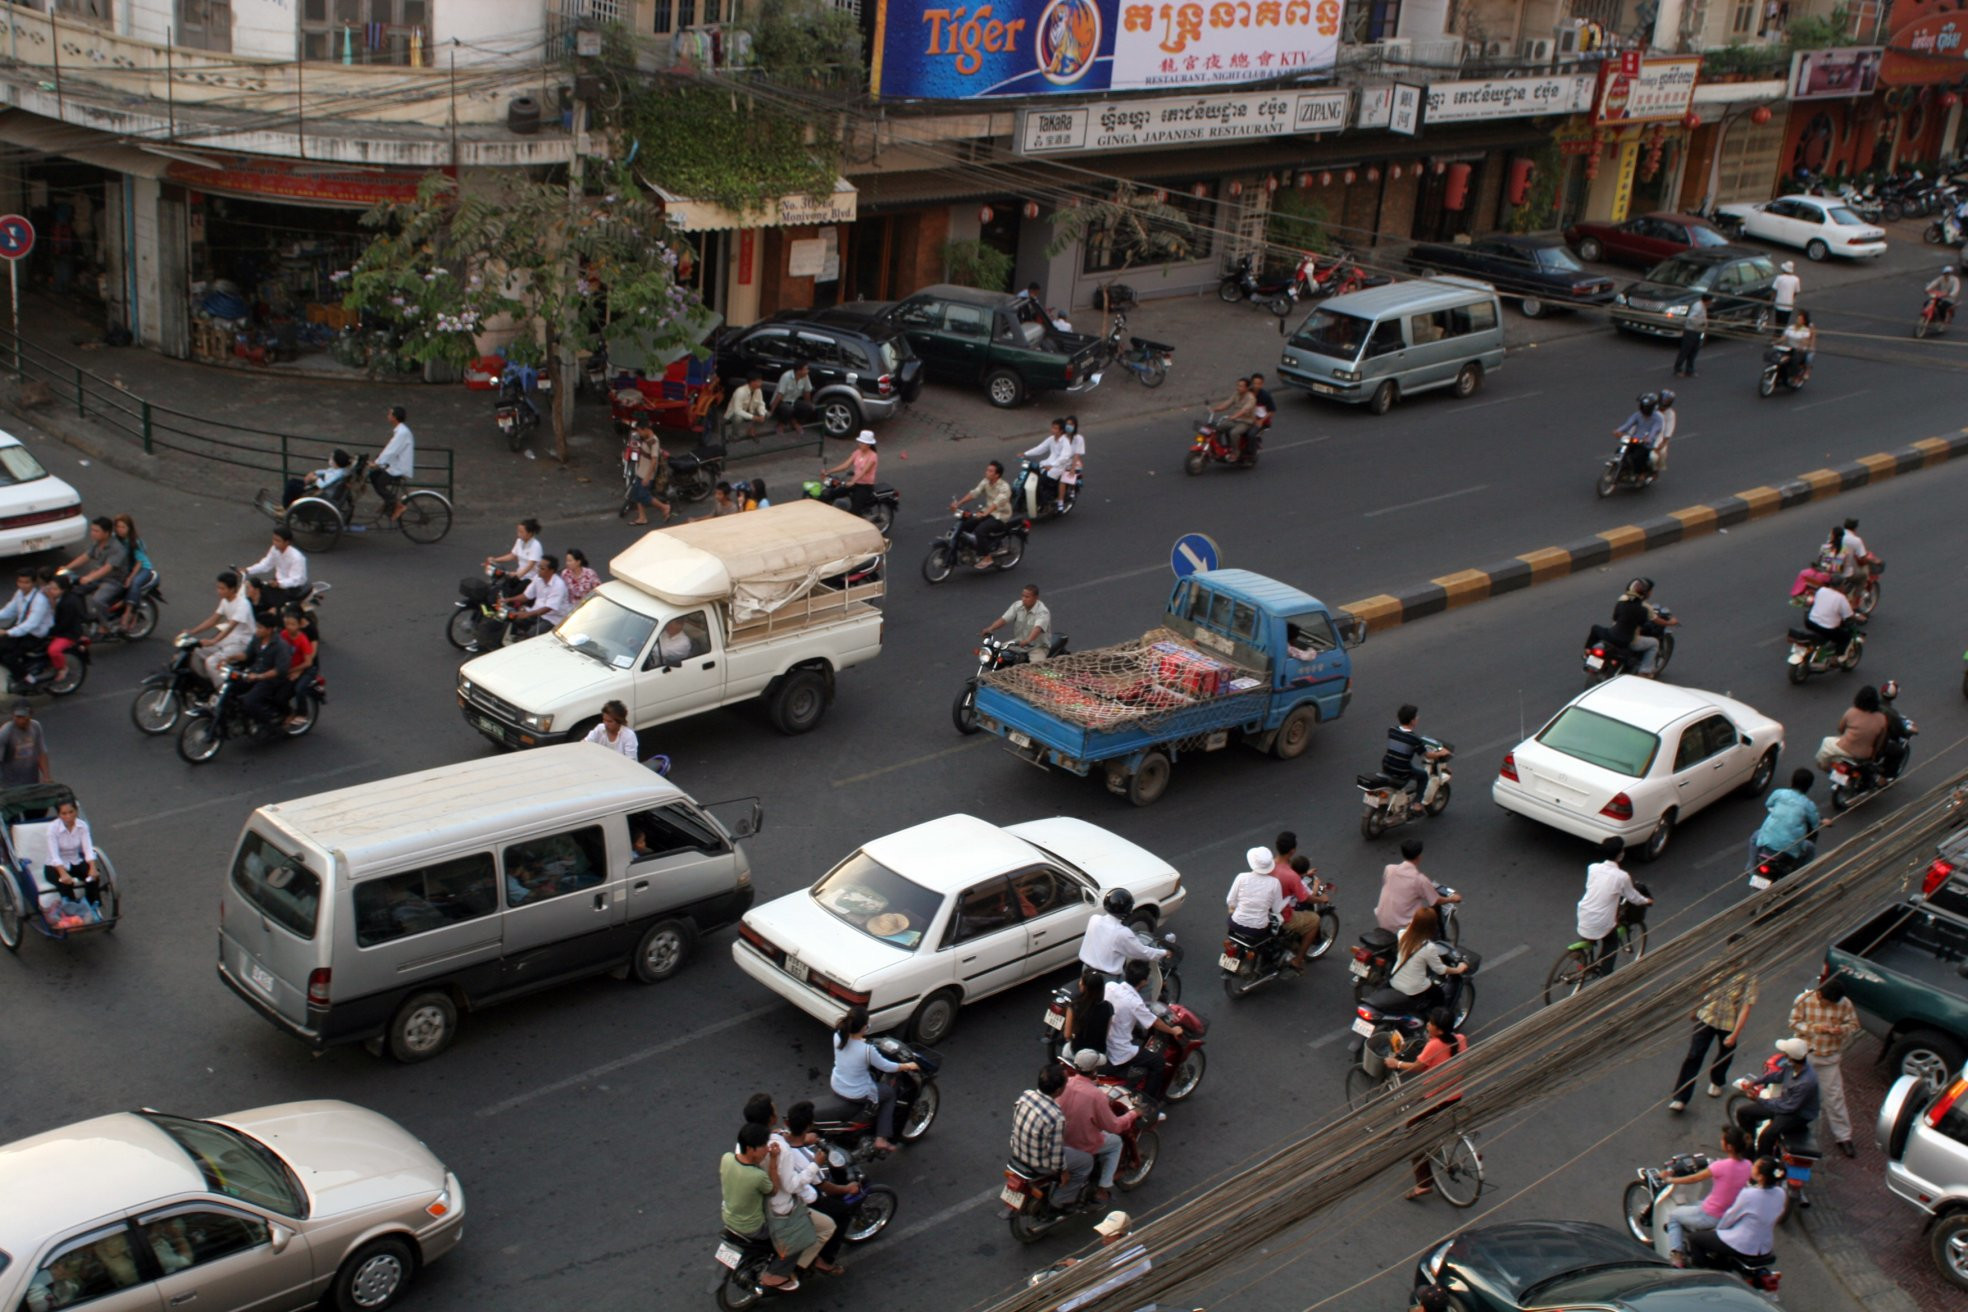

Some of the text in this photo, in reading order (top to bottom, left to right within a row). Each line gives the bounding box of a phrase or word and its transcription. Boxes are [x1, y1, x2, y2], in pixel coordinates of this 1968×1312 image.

[922, 5, 1026, 75] Tiger
[1280, 50, 1310, 66] KTV
[1212, 69, 1241, 81] NIGHT
[1242, 68, 1267, 79] CLUB
[1301, 101, 1342, 122] ZIPANG
[1097, 122, 1285, 147] GINGA JAPANESE RESTAURANT
[782, 207, 855, 222] Monivong Blvd.
